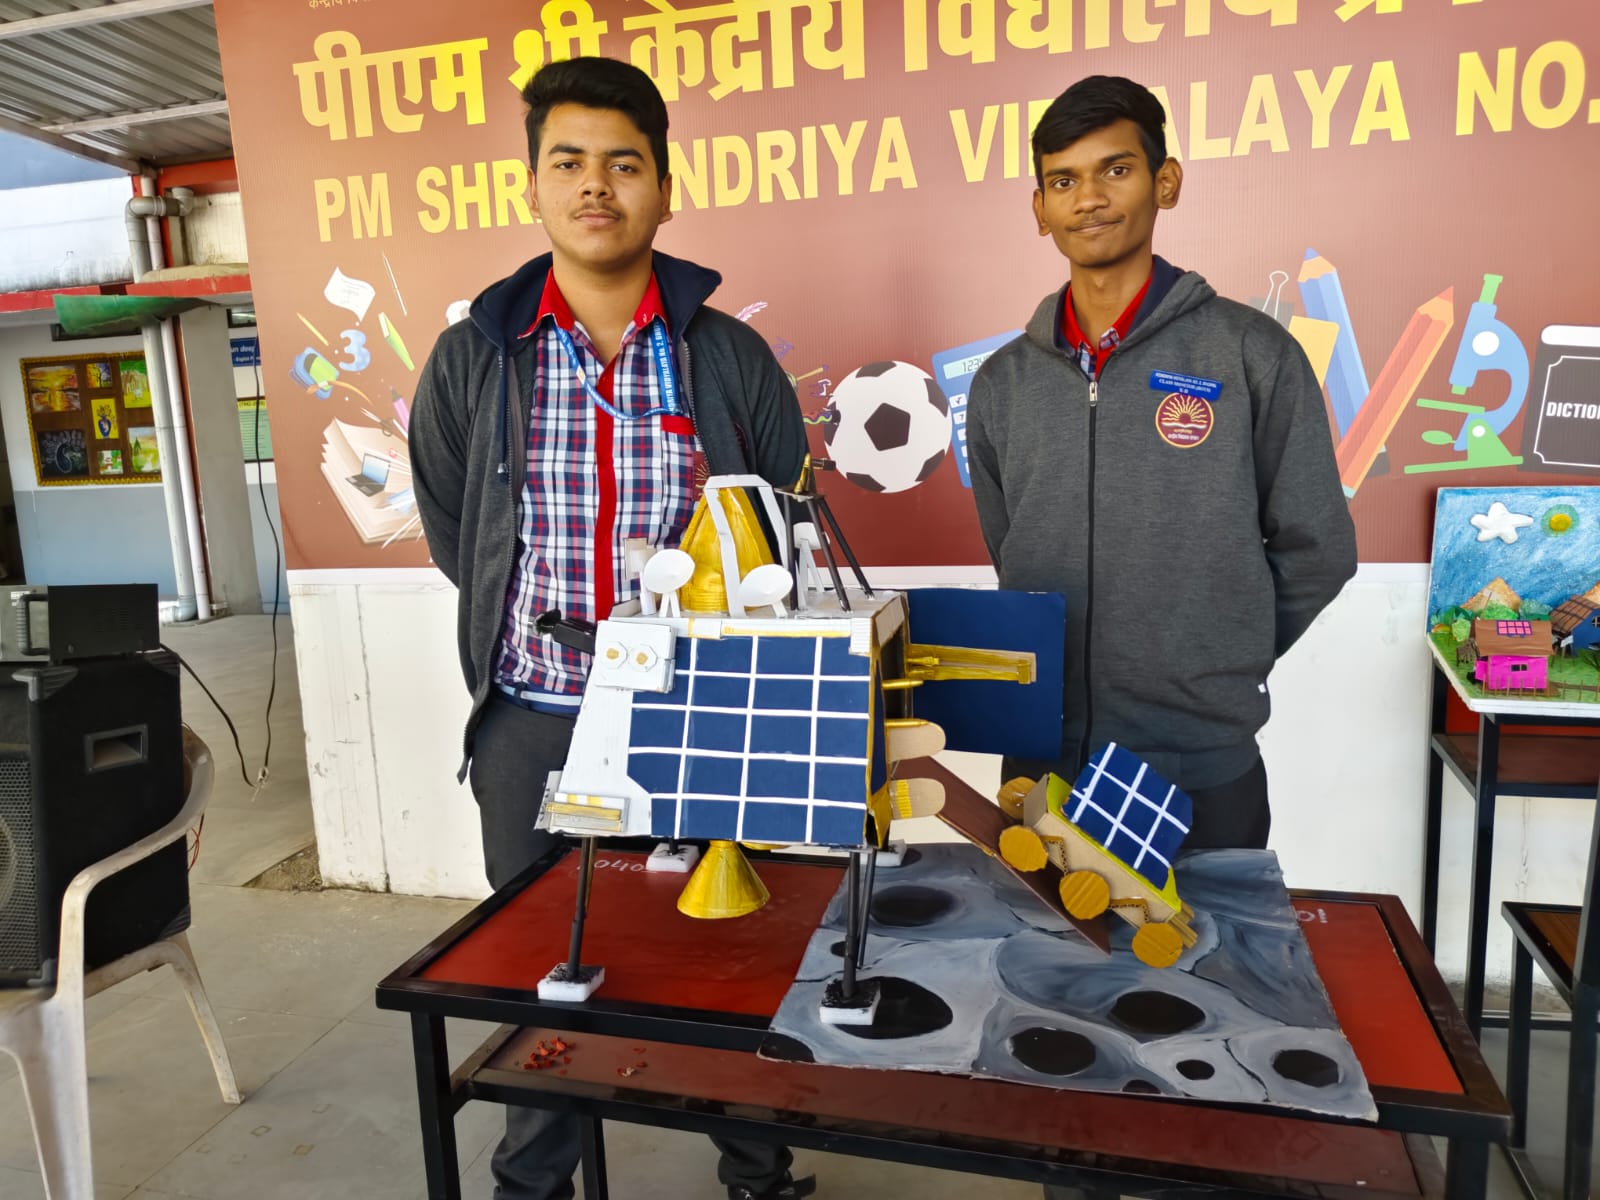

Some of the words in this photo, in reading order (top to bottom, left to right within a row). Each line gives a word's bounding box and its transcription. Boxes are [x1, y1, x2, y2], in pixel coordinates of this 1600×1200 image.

[292, 30, 489, 141] पीएम
[314, 173, 393, 243] PM
[416, 158, 542, 234] SHR
[668, 116, 919, 212] NDRIYA
[949, 59, 1411, 183] VILAYA
